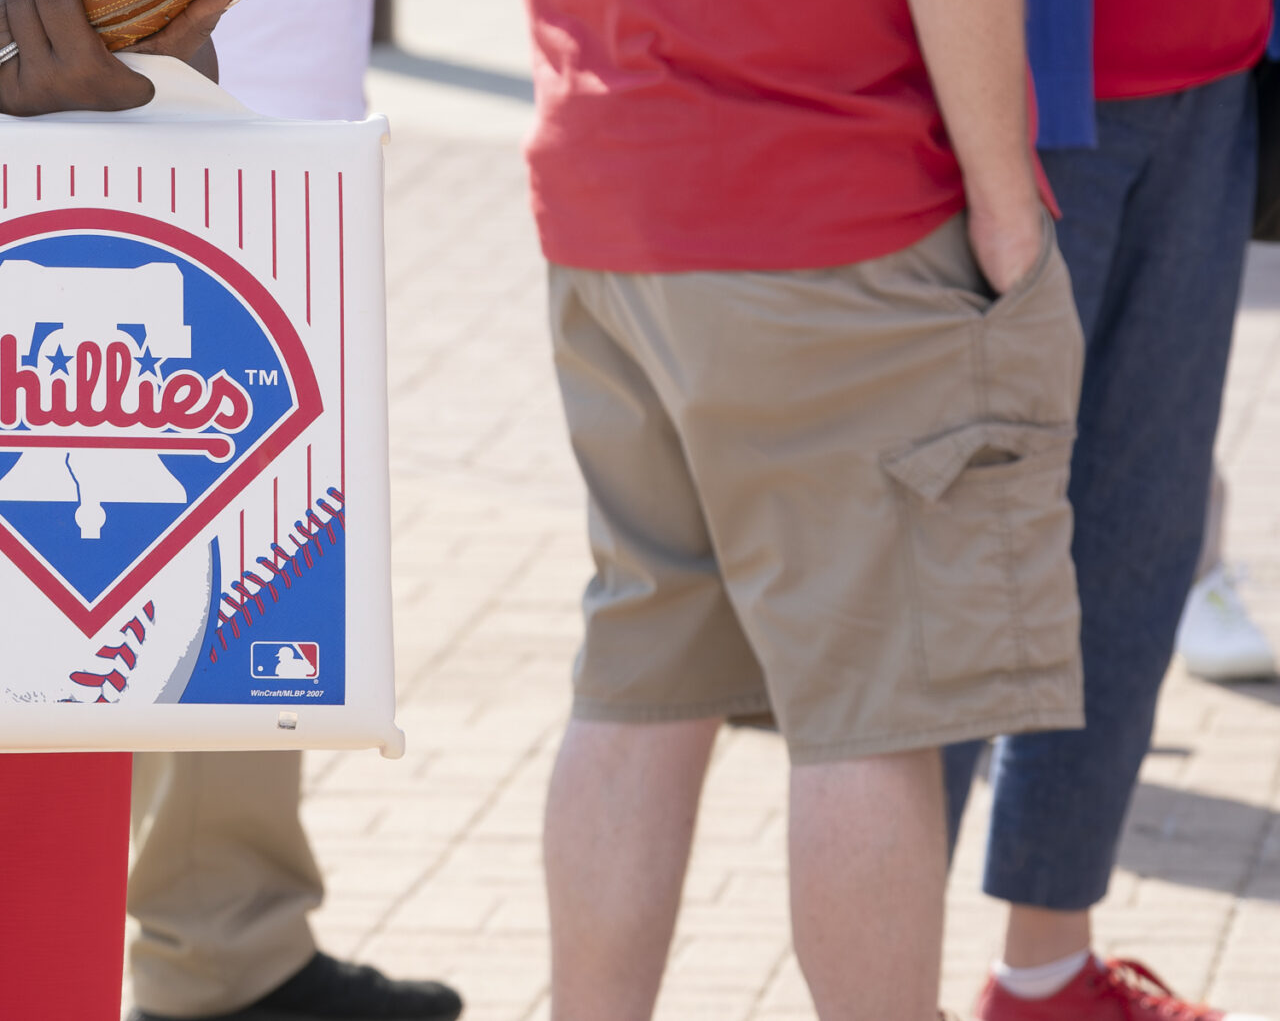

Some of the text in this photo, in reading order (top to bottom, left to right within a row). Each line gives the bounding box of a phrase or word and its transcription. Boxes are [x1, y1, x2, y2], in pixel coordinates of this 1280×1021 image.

[244, 369, 278, 386] TM
[250, 689, 325, 698] WinCraft/MLBP 2007
